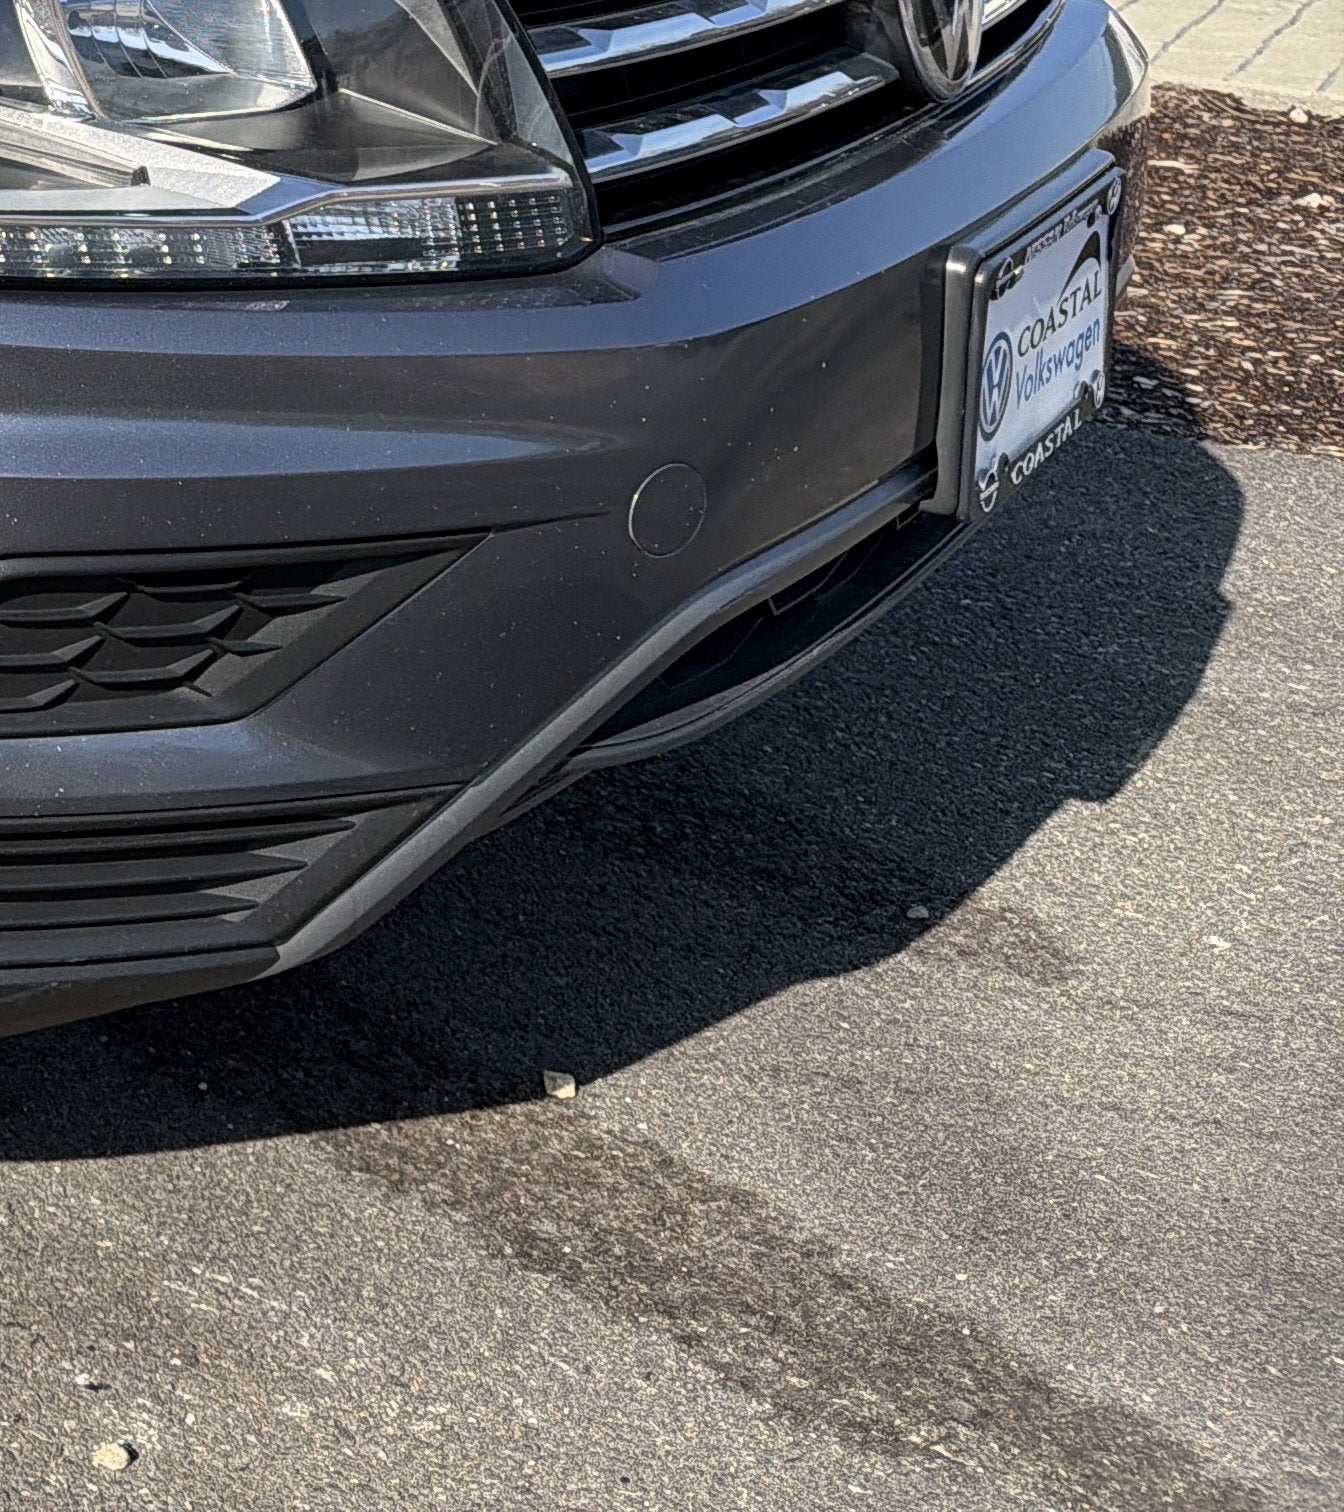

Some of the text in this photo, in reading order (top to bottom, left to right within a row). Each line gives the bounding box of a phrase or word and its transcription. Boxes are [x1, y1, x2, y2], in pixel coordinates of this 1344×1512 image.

[1017, 269, 1102, 358] COASTAL
[1015, 317, 1100, 409] Volkswagen
[1011, 408, 1082, 485] COASTAL
